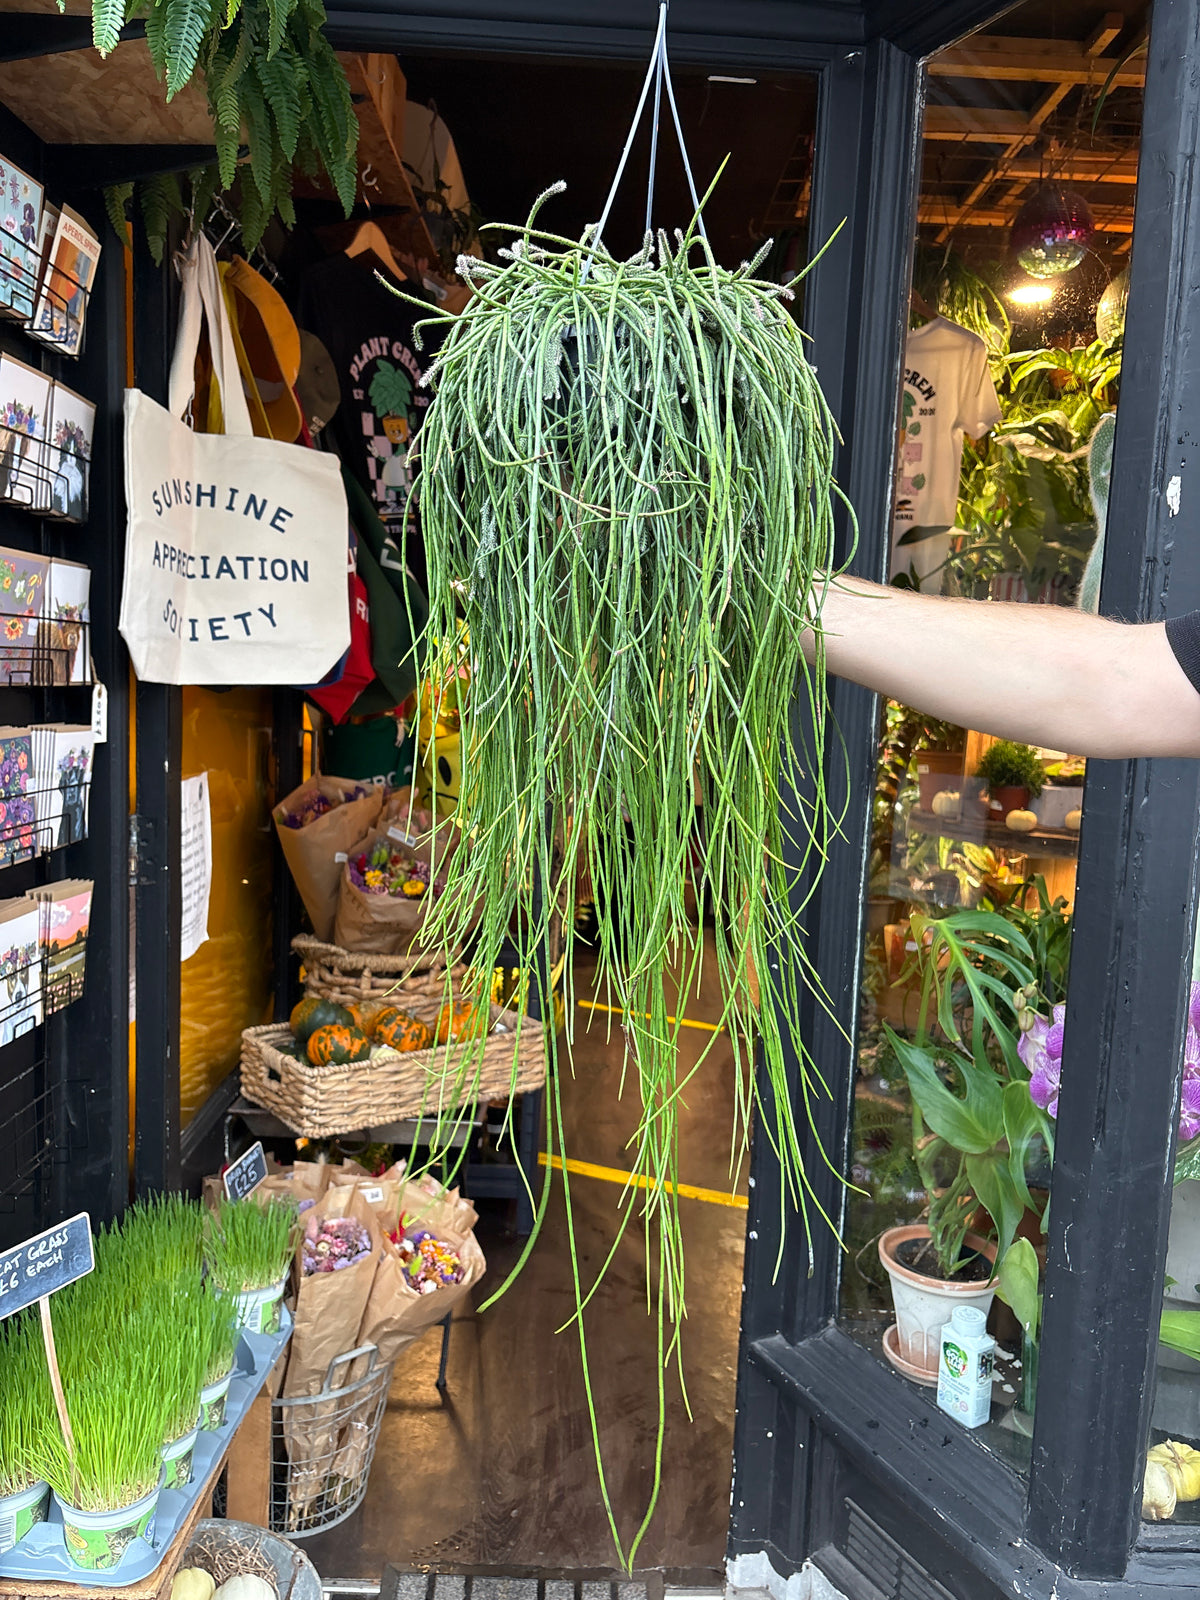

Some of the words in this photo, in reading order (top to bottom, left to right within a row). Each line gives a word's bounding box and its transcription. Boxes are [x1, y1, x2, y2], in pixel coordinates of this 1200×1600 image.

[63, 222, 84, 245] APEROL
[349, 336, 389, 382] PLANT
[152, 479, 294, 534] SUNSHINE
[152, 540, 309, 583] APPRECIATION
[235, 1163, 258, 1198] £25
[27, 1228, 69, 1260] GRASS
[26, 1248, 63, 1277] EACH
